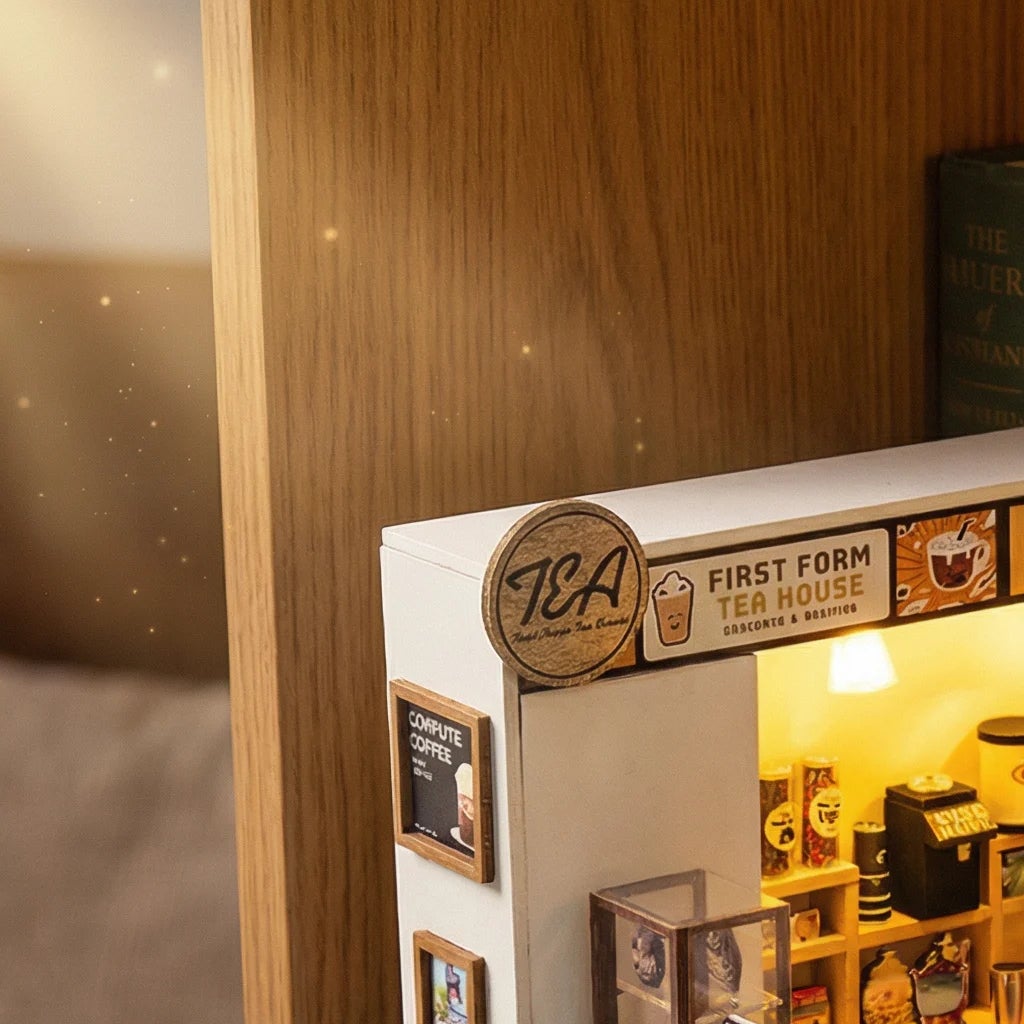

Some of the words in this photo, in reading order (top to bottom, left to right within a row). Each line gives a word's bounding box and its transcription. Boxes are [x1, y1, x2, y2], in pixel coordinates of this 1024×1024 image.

[965, 224, 1008, 254] THE
[505, 545, 629, 627] TEA
[709, 558, 787, 593] FIRST
[797, 543, 871, 578] FORM
[717, 592, 767, 620] TEA
[778, 573, 865, 610] HOUSE
[408, 731, 453, 765] COFFEE
